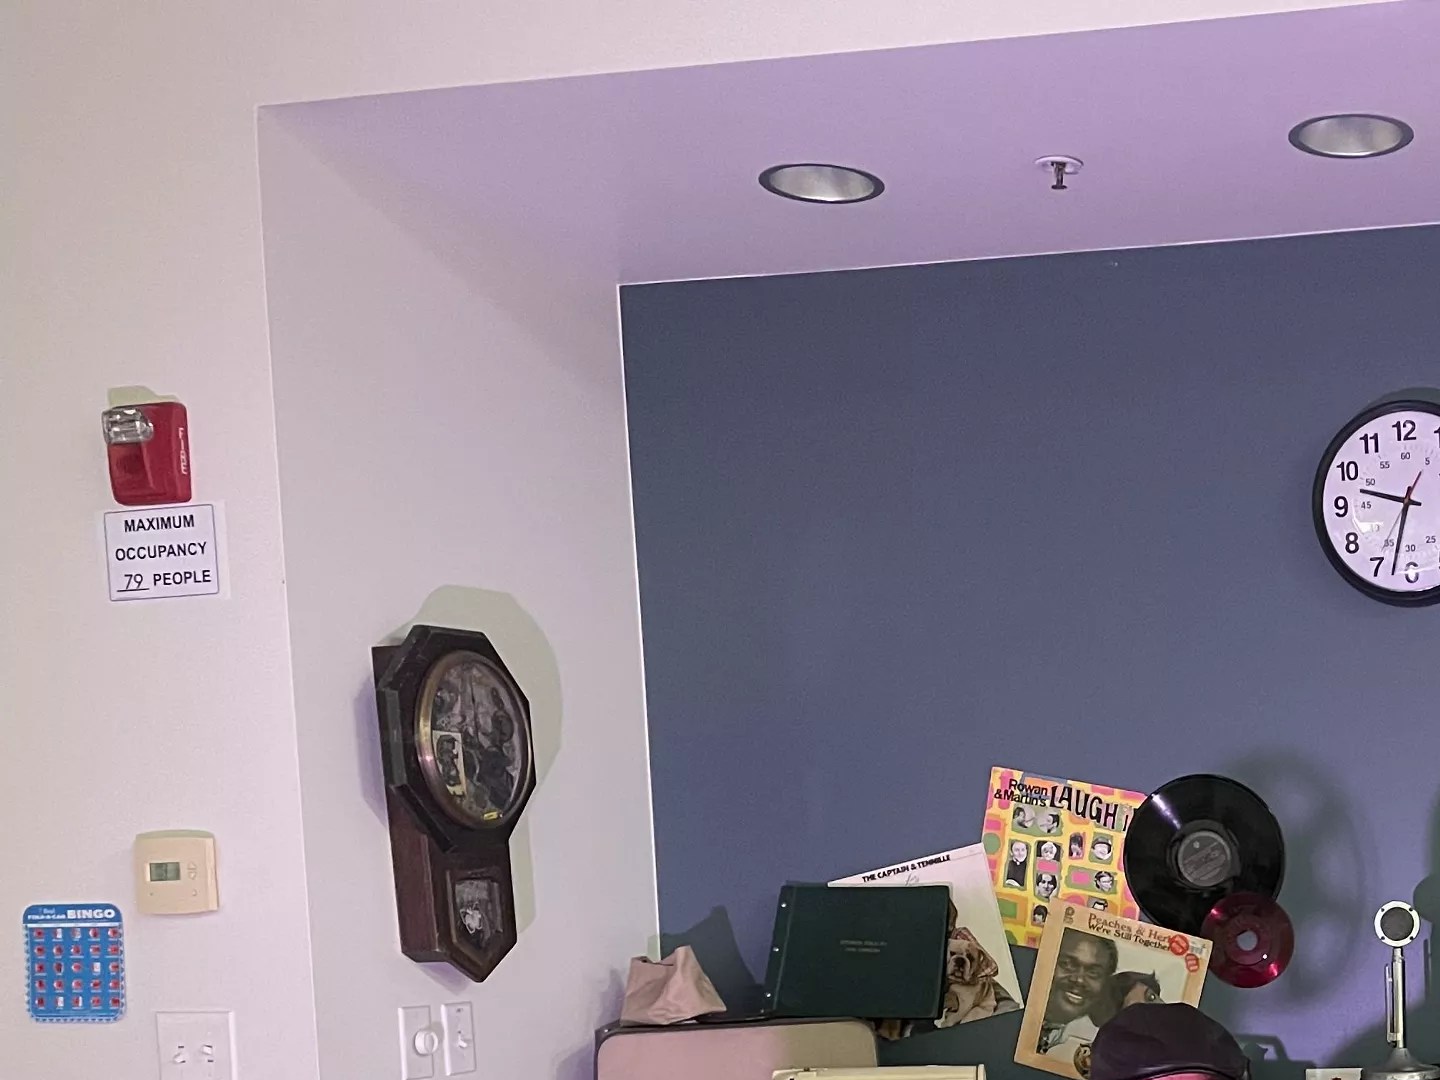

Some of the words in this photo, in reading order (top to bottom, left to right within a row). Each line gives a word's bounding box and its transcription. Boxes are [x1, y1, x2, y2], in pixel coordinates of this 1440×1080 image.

[1392, 420, 1417, 441] 12
[1359, 433, 1379, 454] 11
[1379, 461, 1390, 469] 55
[1400, 452, 1411, 461] 60
[1424, 457, 1431, 466] 5
[1336, 461, 1359, 481] 10
[1365, 478, 1376, 486] 50
[1334, 496, 1348, 517] 9
[1360, 501, 1372, 510] 45
[124, 514, 195, 533] MAXIMUM
[1345, 532, 1360, 554] 8
[1405, 544, 1416, 552] 30
[1425, 535, 1437, 544] 25
[115, 542, 207, 562] OCCUPANCY
[1369, 557, 1384, 577] 7
[123, 573, 144, 590] 79
[153, 569, 212, 586] PEOPLE
[1008, 778, 1048, 796] Rowan
[1050, 785, 1119, 830] LAUGH
[862, 873, 876, 882] THE
[877, 864, 910, 879] CAPTAIN
[917, 854, 951, 869] TENNILLE
[66, 908, 116, 919] BINGO
[1088, 912, 1132, 932] Peaches
[1136, 925, 1145, 936] &
[1088, 923, 1111, 935] We're
[1113, 929, 1132, 941] Still
